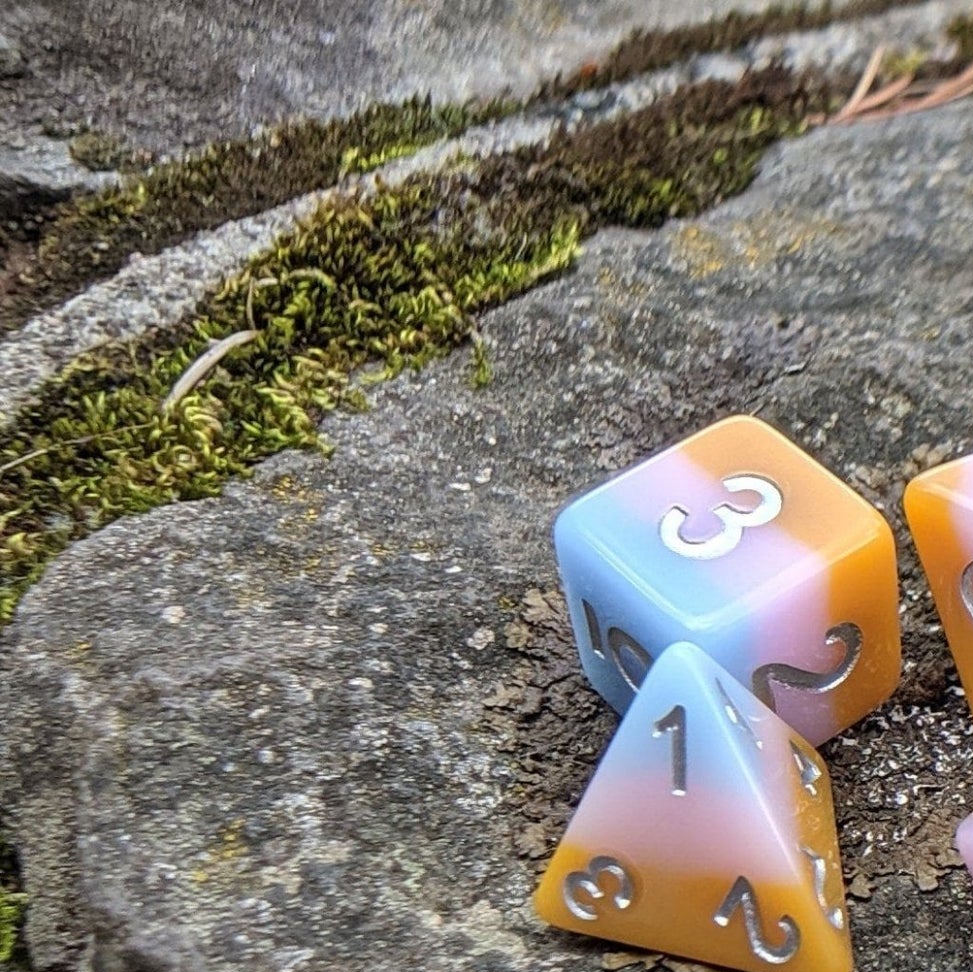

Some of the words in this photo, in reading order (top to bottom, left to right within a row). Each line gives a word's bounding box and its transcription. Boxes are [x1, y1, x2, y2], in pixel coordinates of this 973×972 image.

[658, 473, 784, 560] 3
[752, 622, 864, 713] 2
[652, 704, 687, 797] 1
[563, 855, 636, 921] 3
[713, 875, 801, 965] 2
